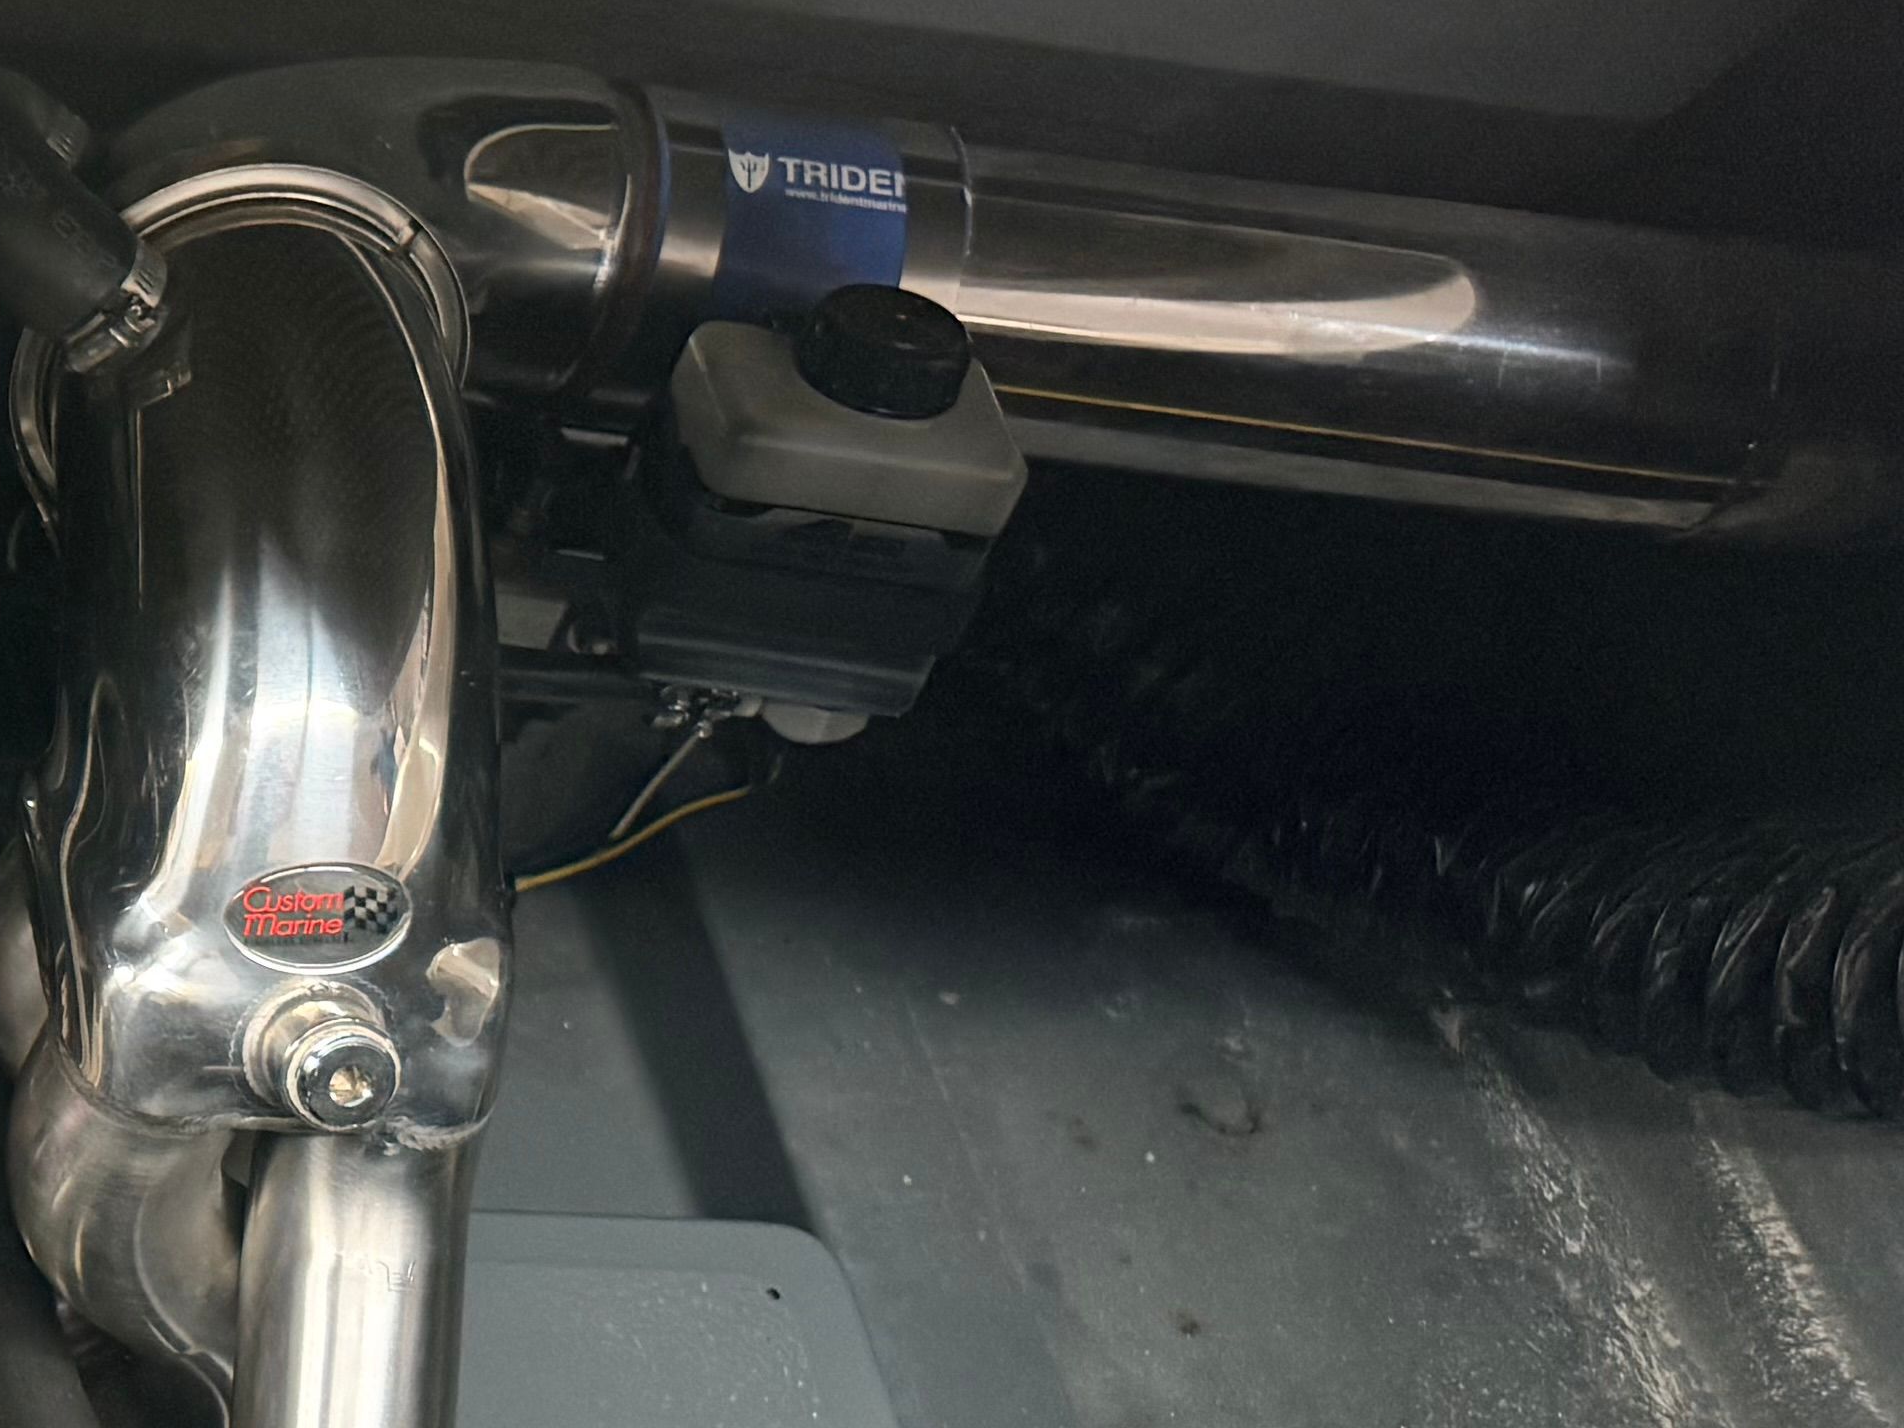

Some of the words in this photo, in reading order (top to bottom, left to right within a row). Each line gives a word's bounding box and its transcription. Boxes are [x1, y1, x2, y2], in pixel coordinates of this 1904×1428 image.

[777, 156, 905, 199] TRIDE
[243, 886, 344, 913] Custom
[243, 912, 344, 937] Marine
